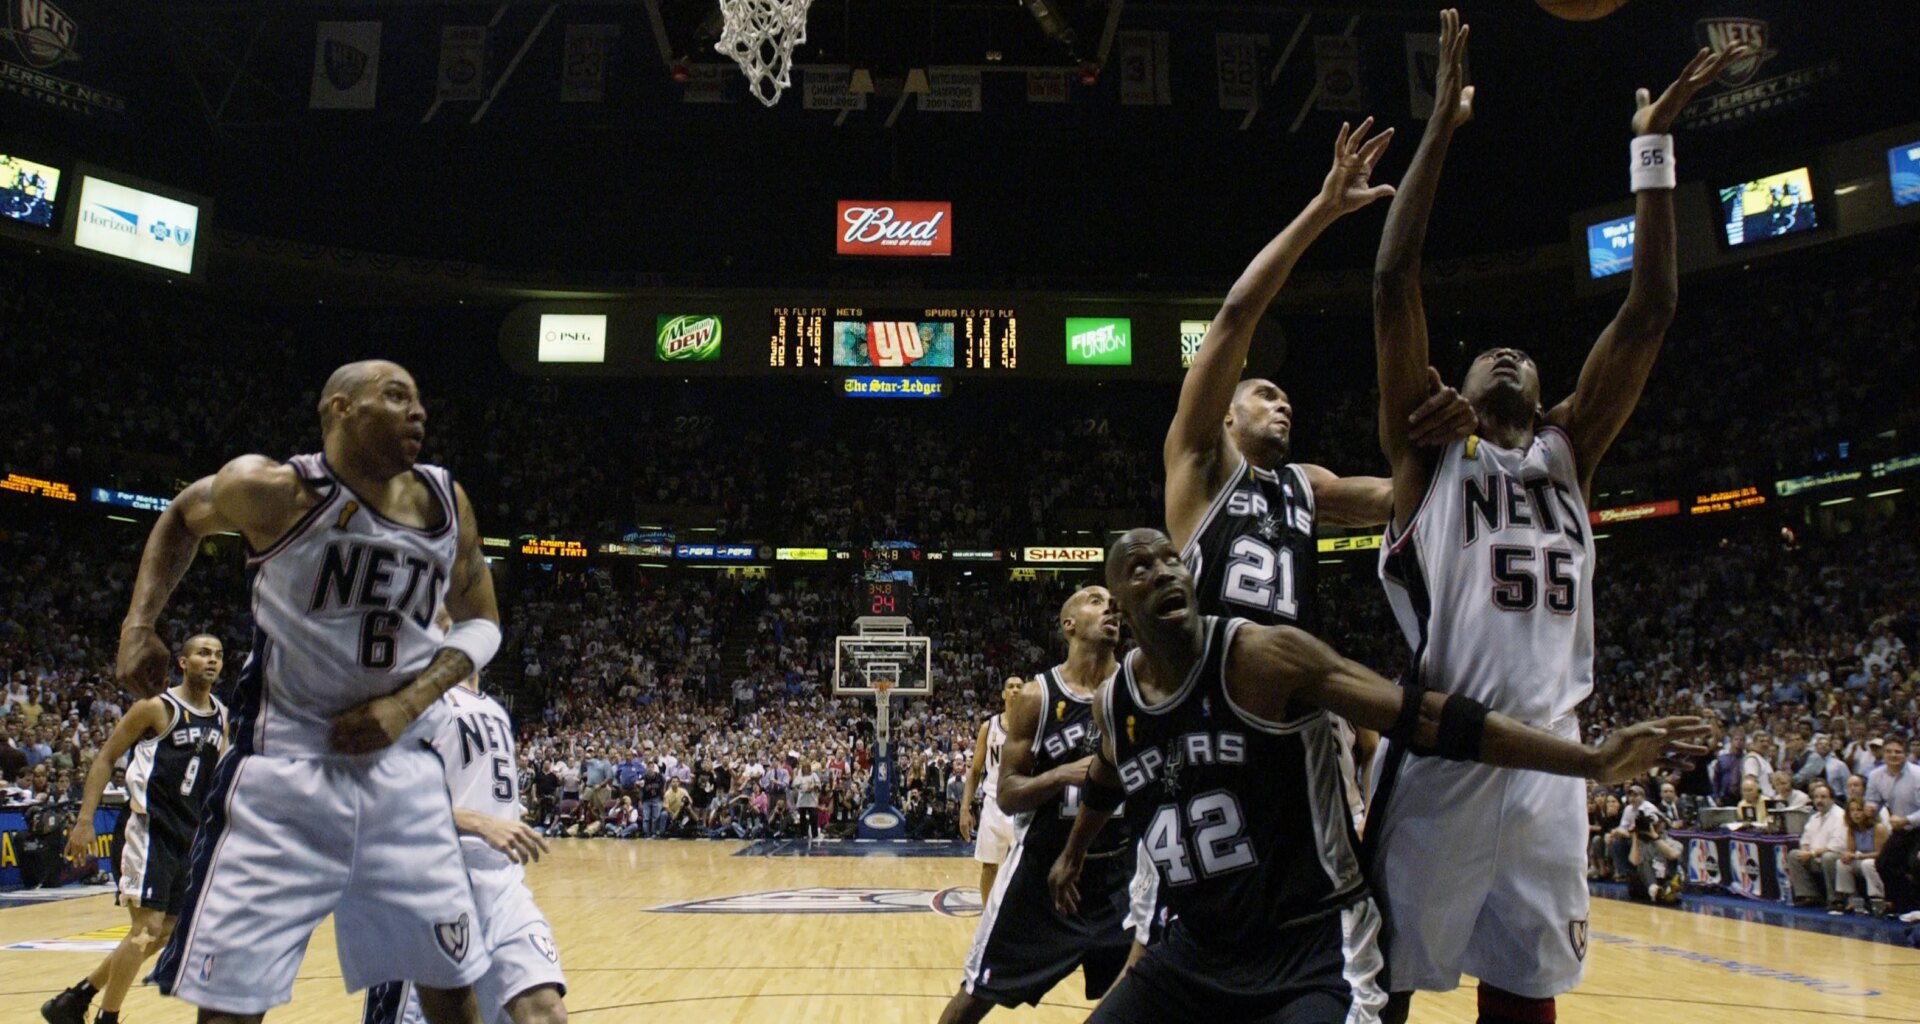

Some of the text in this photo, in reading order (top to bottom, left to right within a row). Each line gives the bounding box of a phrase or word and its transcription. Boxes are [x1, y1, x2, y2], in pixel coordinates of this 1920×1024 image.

[1706, 22, 1764, 54] NETS
[1710, 82, 1779, 112] JERSEY
[1641, 149, 1664, 166] 55
[82, 209, 138, 235] Horizon
[844, 206, 943, 243] Bud
[774, 307, 827, 317] PLR FLS PTS
[836, 308, 863, 317] NETS
[924, 309, 957, 318] SPURS
[961, 309, 1014, 318] FLS PTS PLR
[560, 332, 591, 341] PSEG
[667, 319, 712, 340] Mountain
[1071, 324, 1116, 351] FIRST
[1082, 333, 1126, 359] UNION
[844, 379, 942, 395] The Star-Ledger
[1461, 470, 1586, 551] NETS
[522, 545, 556, 557] HUSTLE
[689, 547, 713, 556] PEPSI
[727, 547, 752, 556] PEPSI
[1029, 549, 1099, 560] SHARP
[307, 541, 445, 630] NETS
[869, 583, 892, 594] 34.8
[1220, 534, 1298, 621] 21
[1490, 543, 1577, 616] 55
[872, 595, 895, 613] 24
[358, 608, 403, 673] 6
[180, 755, 201, 797] 9
[1118, 730, 1247, 796] SPURS
[491, 753, 515, 803] 5
[1143, 787, 1259, 887] 42
